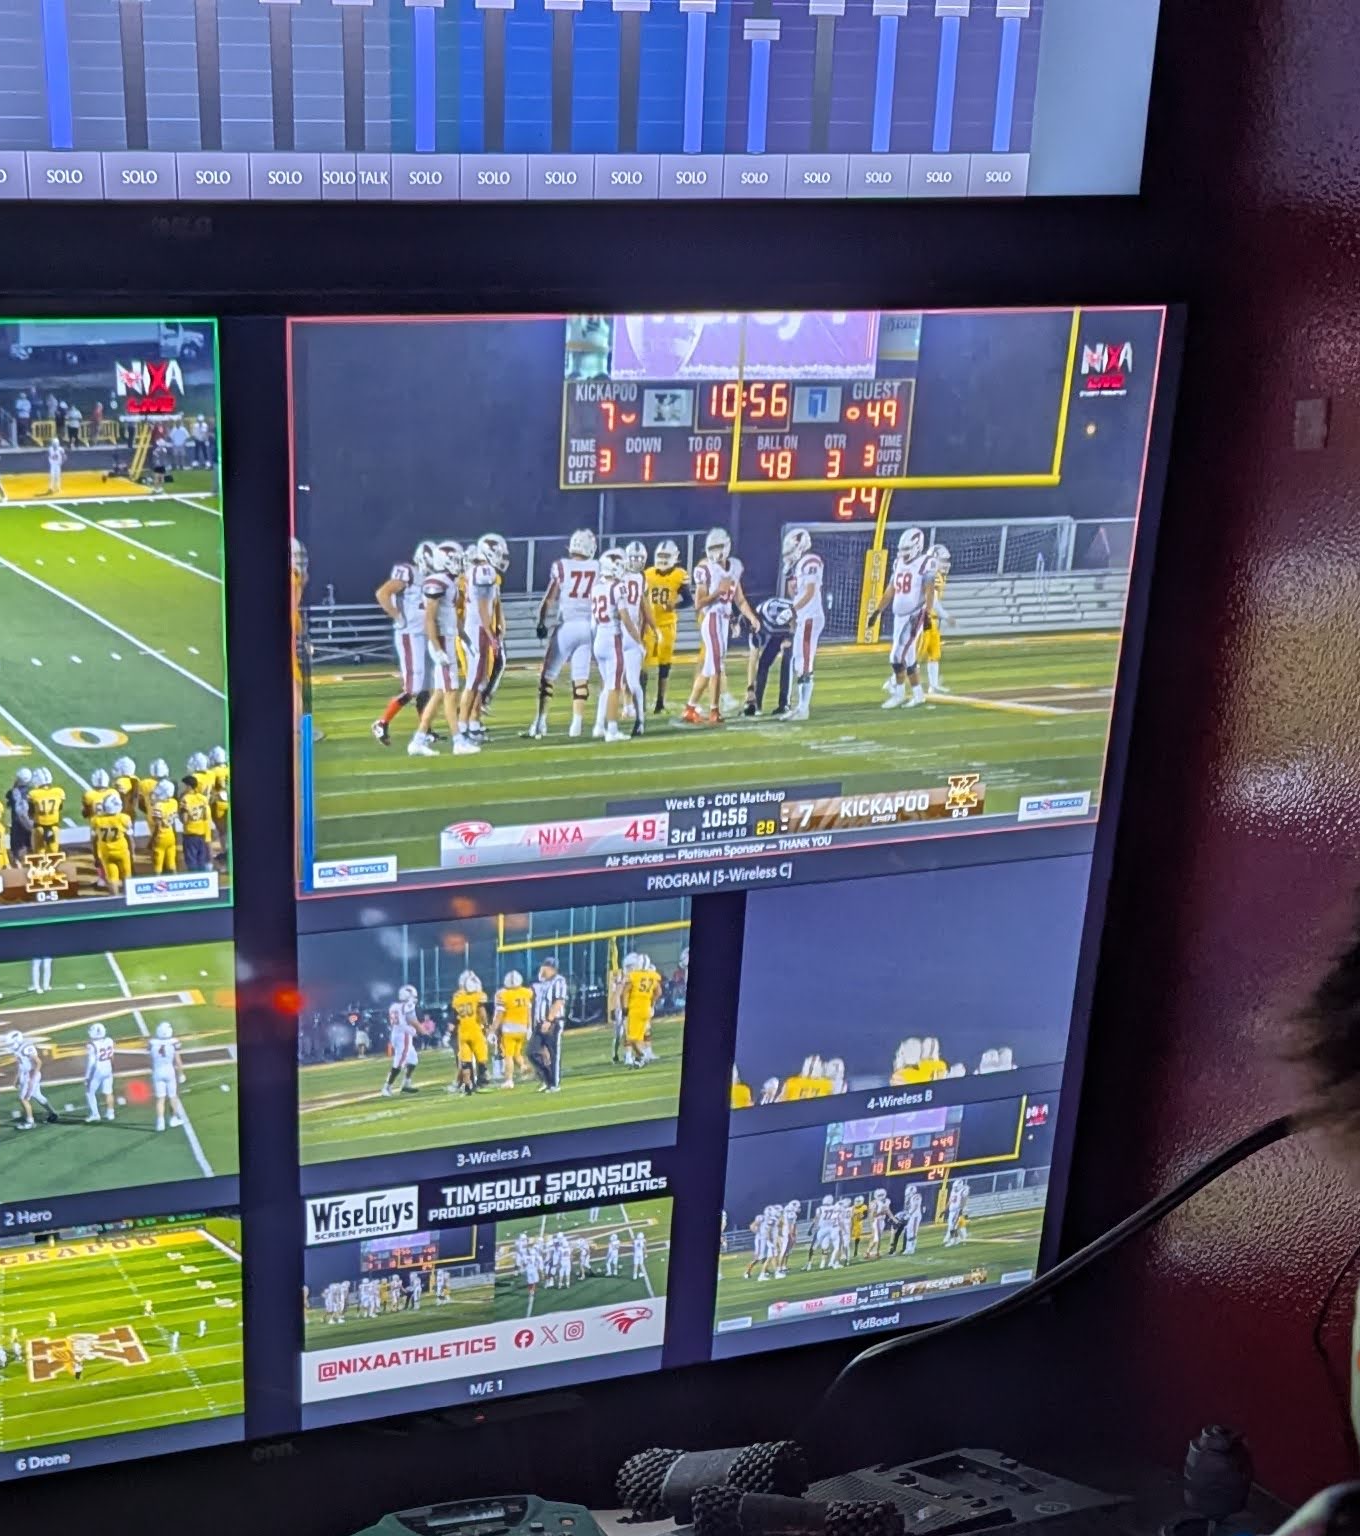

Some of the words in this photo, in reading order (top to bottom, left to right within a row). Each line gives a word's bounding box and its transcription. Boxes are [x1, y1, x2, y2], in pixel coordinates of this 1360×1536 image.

[46, 169, 83, 185] SOLO
[122, 169, 157, 185] SOLO
[195, 169, 231, 185] SOLO
[268, 170, 302, 186] SOLO
[322, 170, 356, 186] SOLO
[359, 170, 389, 186] TALK
[409, 170, 442, 186] SOLO
[477, 170, 510, 186] SOLO
[545, 170, 577, 186] SOLO
[611, 170, 642, 186] SOLO
[676, 170, 707, 185] SOLO
[741, 171, 768, 185] SOLO
[804, 171, 830, 185] SOLO
[865, 171, 892, 184] SOLO
[926, 171, 952, 184] SOLO
[985, 171, 1011, 184] SOLO
[575, 383, 638, 402] KICKAPOO
[852, 381, 902, 400] GUEST
[709, 382, 789, 418] 10:56
[866, 400, 898, 429] 49
[570, 438, 597, 453] TIME
[625, 436, 662, 454] DOWN
[687, 436, 702, 452] TO
[703, 436, 722, 452] GO
[757, 435, 782, 451] BALL
[783, 434, 799, 450] ON
[879, 434, 903, 448] TIME
[568, 454, 597, 469] OUTS
[599, 448, 612, 473] 3
[759, 450, 792, 480] 48
[826, 449, 841, 478] 3
[863, 444, 876, 468] 3
[876, 449, 902, 463] OUTS
[643, 455, 652, 481] 1
[695, 452, 720, 481] 10
[875, 463, 901, 477] LEFT
[568, 469, 595, 485] LEFT
[837, 487, 877, 517] 24
[664, 797, 696, 811] Week
[739, 791, 786, 805] Matchup
[840, 792, 930, 819] KICKAPOO
[701, 807, 748, 829] 10:56
[798, 804, 815, 828] 7
[537, 825, 584, 847] NIXA
[623, 819, 657, 843] 49
[670, 826, 697, 844] 3rd
[606, 855, 620, 868] Air
[621, 852, 665, 868] Services
[677, 844, 723, 862] Platinum
[724, 841, 766, 859] Sponsor
[778, 838, 810, 851] THANK
[811, 835, 833, 848] YOU
[646, 870, 712, 891] PROGRAM
[712, 865, 778, 887] [5-Wireless
[779, 861, 793, 880] C]
[135, 882, 155, 895] AIR
[166, 877, 210, 892] SERVICES
[866, 1092, 923, 1111] 4-Wireless
[456, 1147, 520, 1168] 3-Wireless
[521, 1144, 533, 1159] A
[441, 1175, 543, 1208] TIMEOUT
[544, 1159, 653, 1193] SPONSOR
[427, 1204, 477, 1223] PROUD
[477, 1197, 542, 1216] SPONSOR
[543, 1192, 563, 1208] OF
[563, 1187, 597, 1204] NIXA
[597, 1176, 669, 1200] ATHLETICS
[4, 1211, 16, 1227] 2
[16, 1209, 53, 1225] Hero
[310, 1193, 416, 1232] WiseGuys
[314, 1227, 357, 1242] SCREEN
[357, 1223, 391, 1236] PRINT
[851, 1311, 901, 1332] VidBoard
[318, 1335, 498, 1384] @NIXAATHLETICS
[469, 1380, 495, 1397] M/E
[496, 1379, 504, 1393] 1
[15, 1458, 27, 1473] 6
[28, 1452, 71, 1470] Drone
